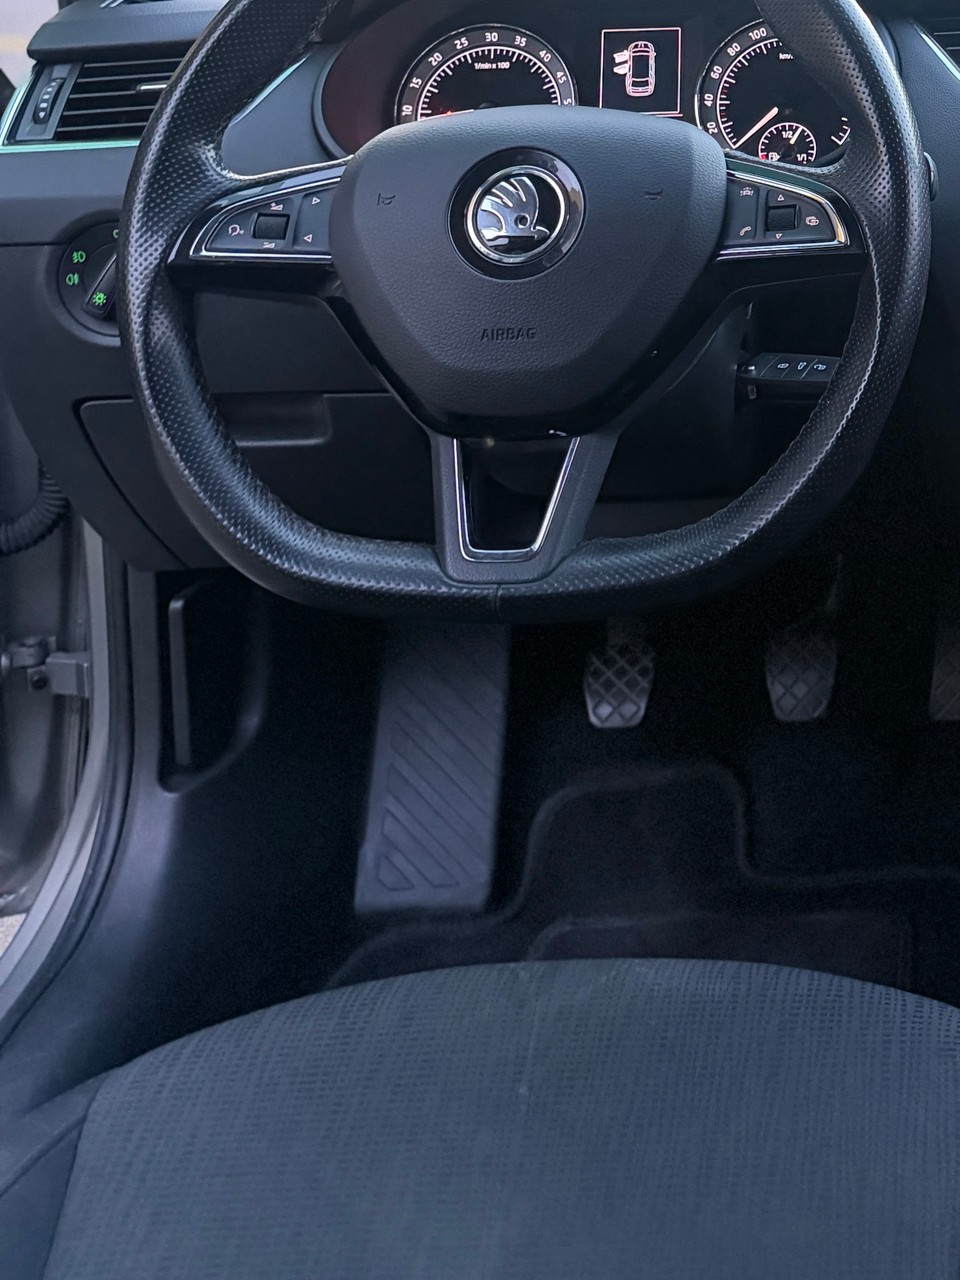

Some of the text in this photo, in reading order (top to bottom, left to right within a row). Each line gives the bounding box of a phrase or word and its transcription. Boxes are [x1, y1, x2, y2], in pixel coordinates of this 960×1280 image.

[484, 32, 498, 42] 30
[514, 35, 527, 47] 35
[748, 27, 767, 41] 100
[454, 37, 469, 50] 25
[727, 42, 741, 57] 80
[428, 52, 443, 66] 20
[538, 49, 552, 63] 40
[474, 62, 492, 70] 1/min
[497, 61, 510, 69] 100
[710, 65, 723, 80] 60
[409, 77, 423, 89] 15
[556, 70, 567, 84] 45
[703, 93, 714, 107] 40
[402, 104, 413, 116] 10
[706, 121, 718, 135] 20
[781, 130, 793, 139] 1/2
[480, 327, 537, 341] AIRBAG
